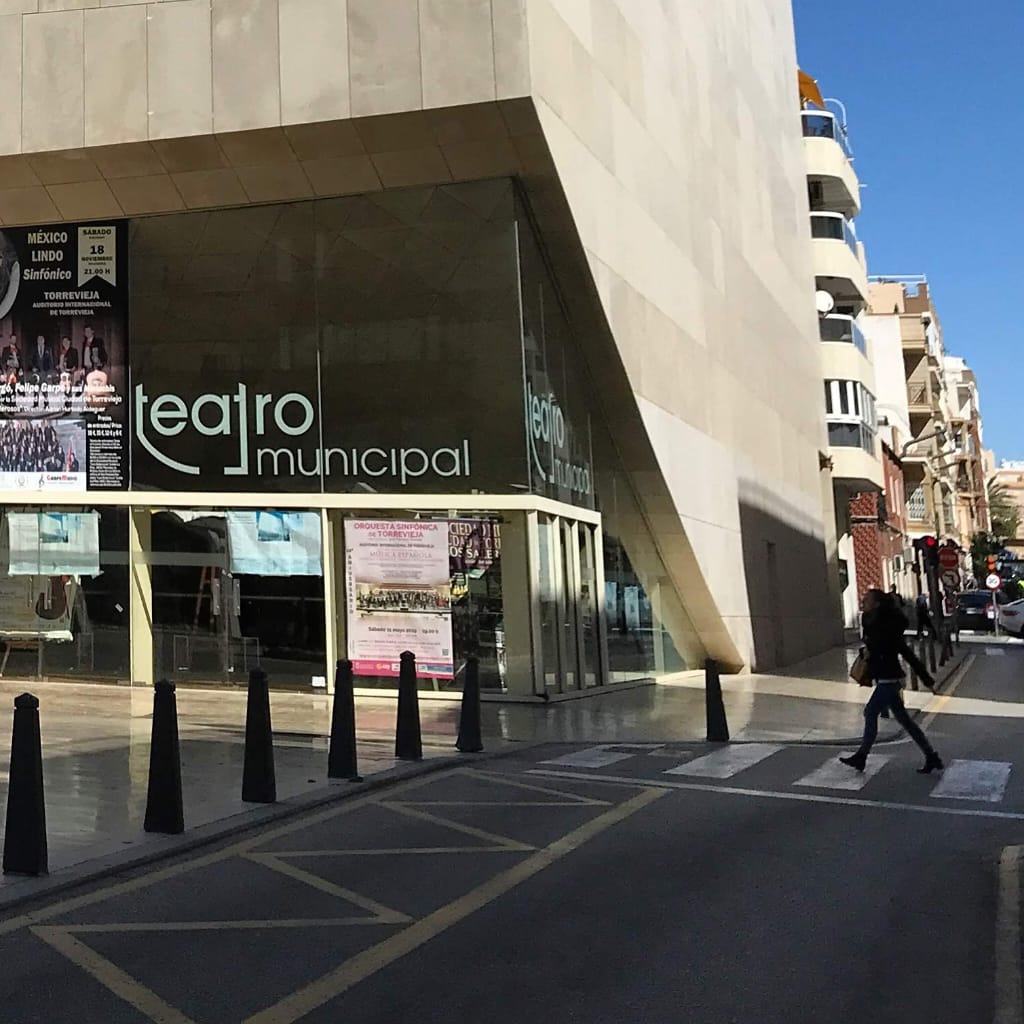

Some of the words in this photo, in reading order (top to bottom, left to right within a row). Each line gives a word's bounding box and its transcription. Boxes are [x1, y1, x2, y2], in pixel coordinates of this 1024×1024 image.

[27, 230, 68, 244] MÉXICO
[31, 250, 64, 262] LINDO
[89, 245, 104, 255] 18
[23, 267, 72, 281] Sinfónico
[44, 290, 100, 301] TORREVIEJA
[135, 381, 315, 475] teatro
[527, 381, 565, 484] teatro
[256, 439, 471, 485] municipal
[354, 522, 396, 530] ORQUESTA
[397, 522, 439, 531] SINFÓNICA
